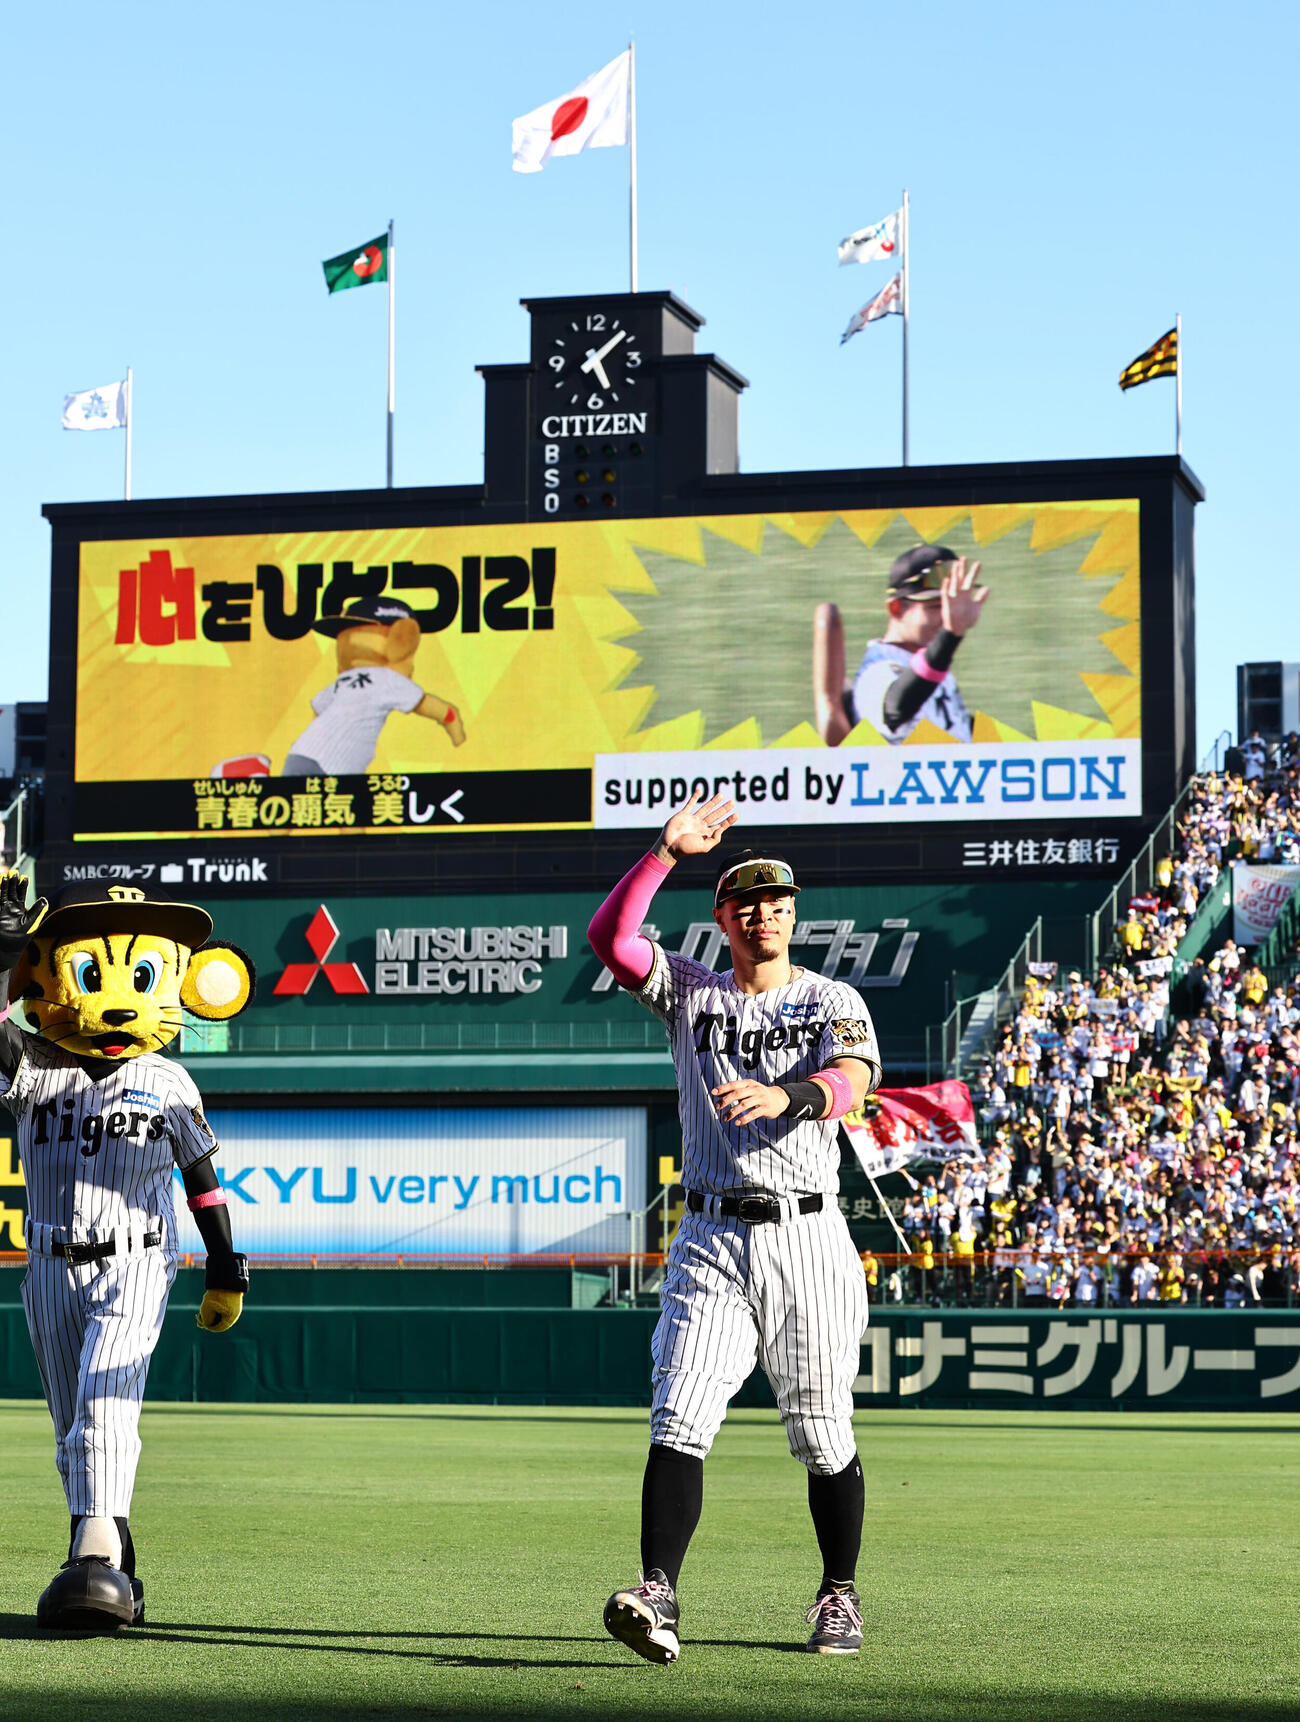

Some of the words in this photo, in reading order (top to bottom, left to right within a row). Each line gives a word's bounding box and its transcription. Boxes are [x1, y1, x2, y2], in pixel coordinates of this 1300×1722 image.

[586, 314, 606, 331] 12
[548, 356, 566, 373] 9
[626, 351, 642, 368] 3
[587, 393, 604, 410] 6
[541, 412, 647, 438] CITIZEN
[545, 444, 560, 464] B
[544, 468, 560, 488] S
[604, 766, 790, 809] supported
[804, 764, 844, 805] by
[849, 756, 1127, 806] LAWSON
[195, 793, 356, 829] 青春の覇気
[372, 788, 465, 825] 美しく
[962, 838, 1120, 867] 三井住友銀行
[187, 857, 268, 883] Trunk
[375, 925, 568, 962] MITSUBISHI
[375, 961, 543, 996] ELECTRIC
[692, 1010, 826, 1071] Tigers
[122, 1089, 160, 1108] Joshin
[31, 1098, 167, 1157] Tigers
[369, 1174, 481, 1210] very
[492, 1165, 622, 1204] much
